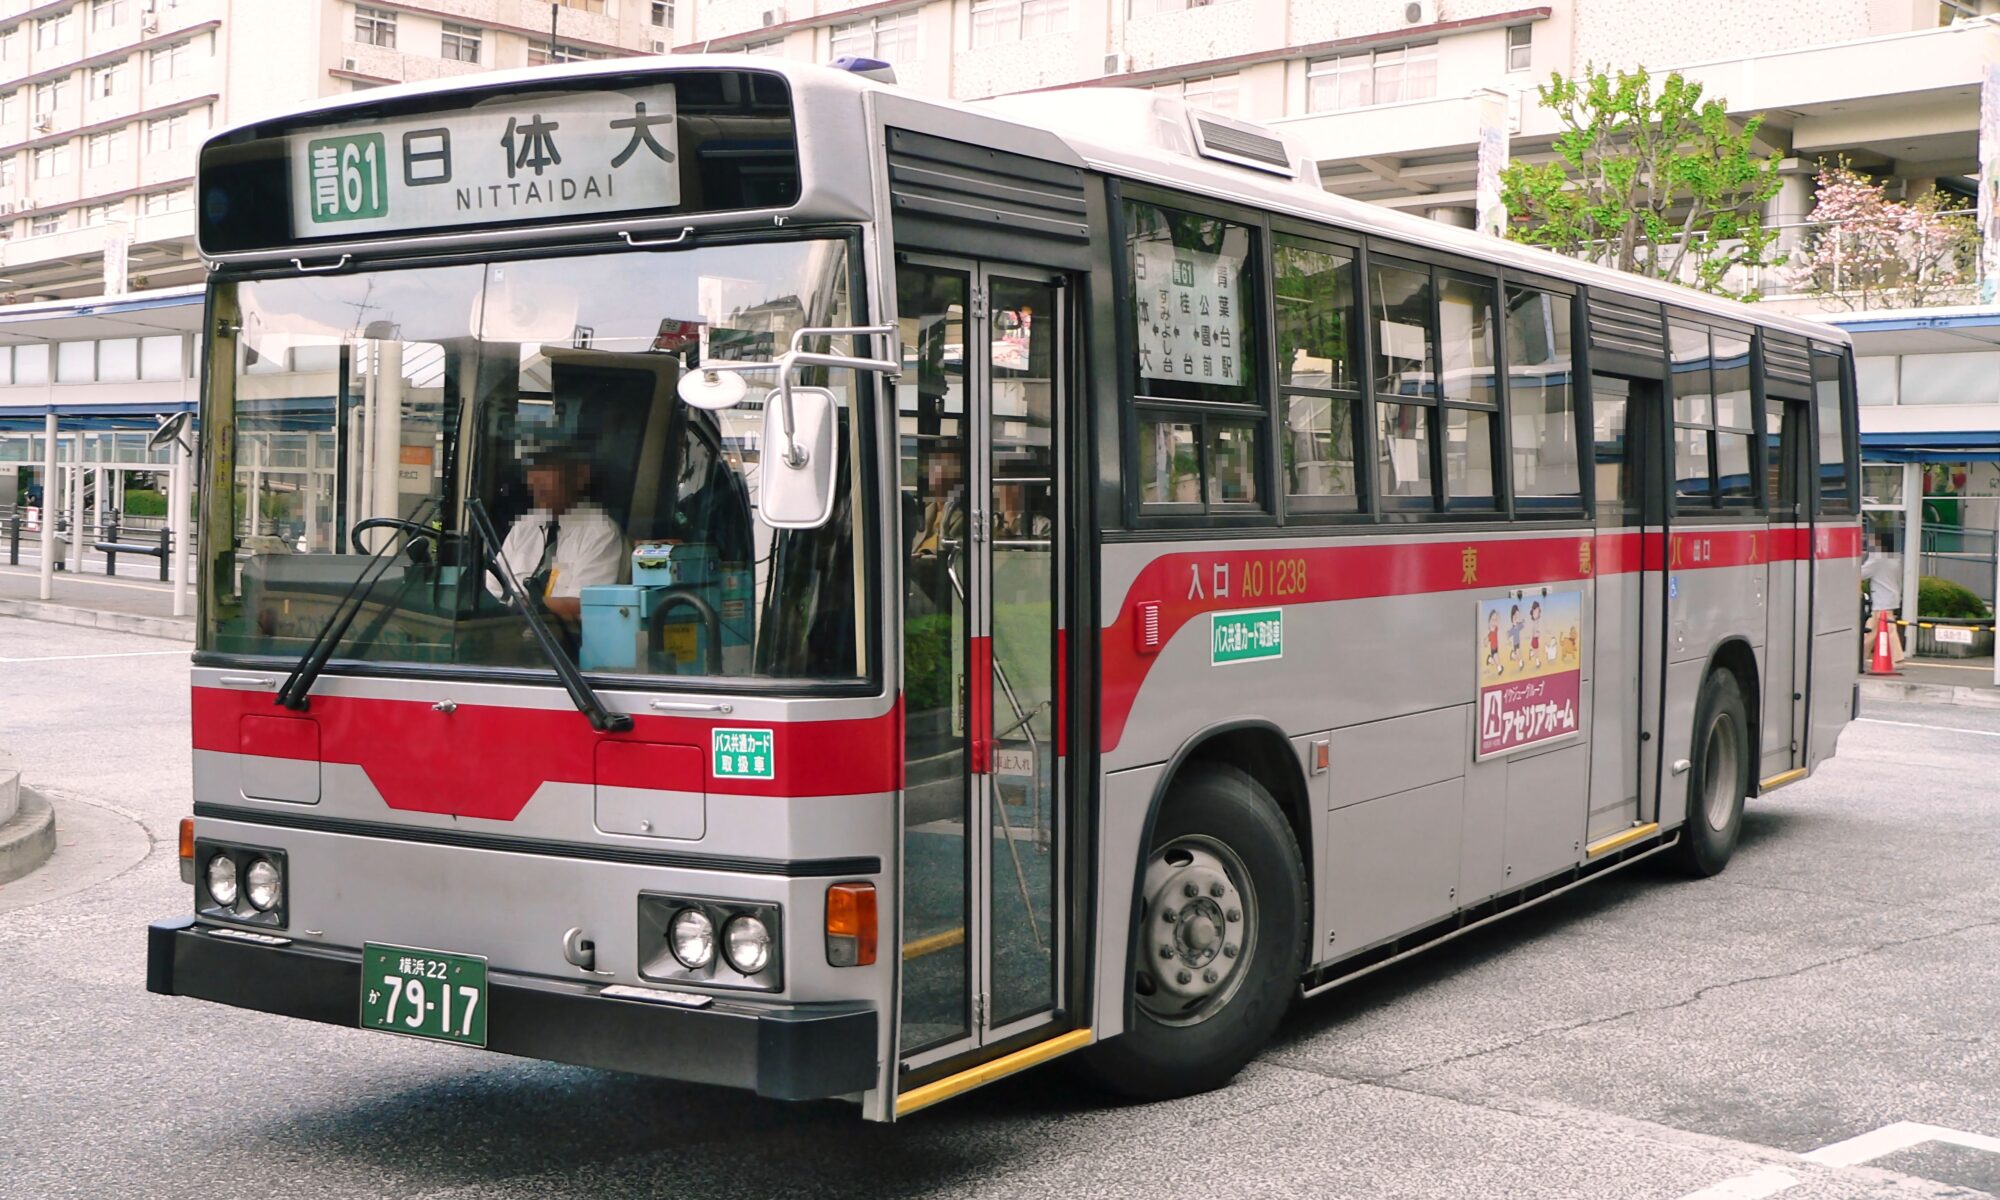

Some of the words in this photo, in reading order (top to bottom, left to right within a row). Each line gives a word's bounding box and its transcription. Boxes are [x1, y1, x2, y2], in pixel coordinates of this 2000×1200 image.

[402, 101, 676, 187] 日体大
[312, 140, 380, 214] 青61
[456, 173, 615, 211] NITTAIDAI
[1188, 562, 1230, 600] 入口
[715, 733, 771, 754] バス共通カード
[1502, 698, 1575, 745] アゼリアホーム
[368, 988, 381, 1005] か
[383, 975, 479, 1036] 79-17
